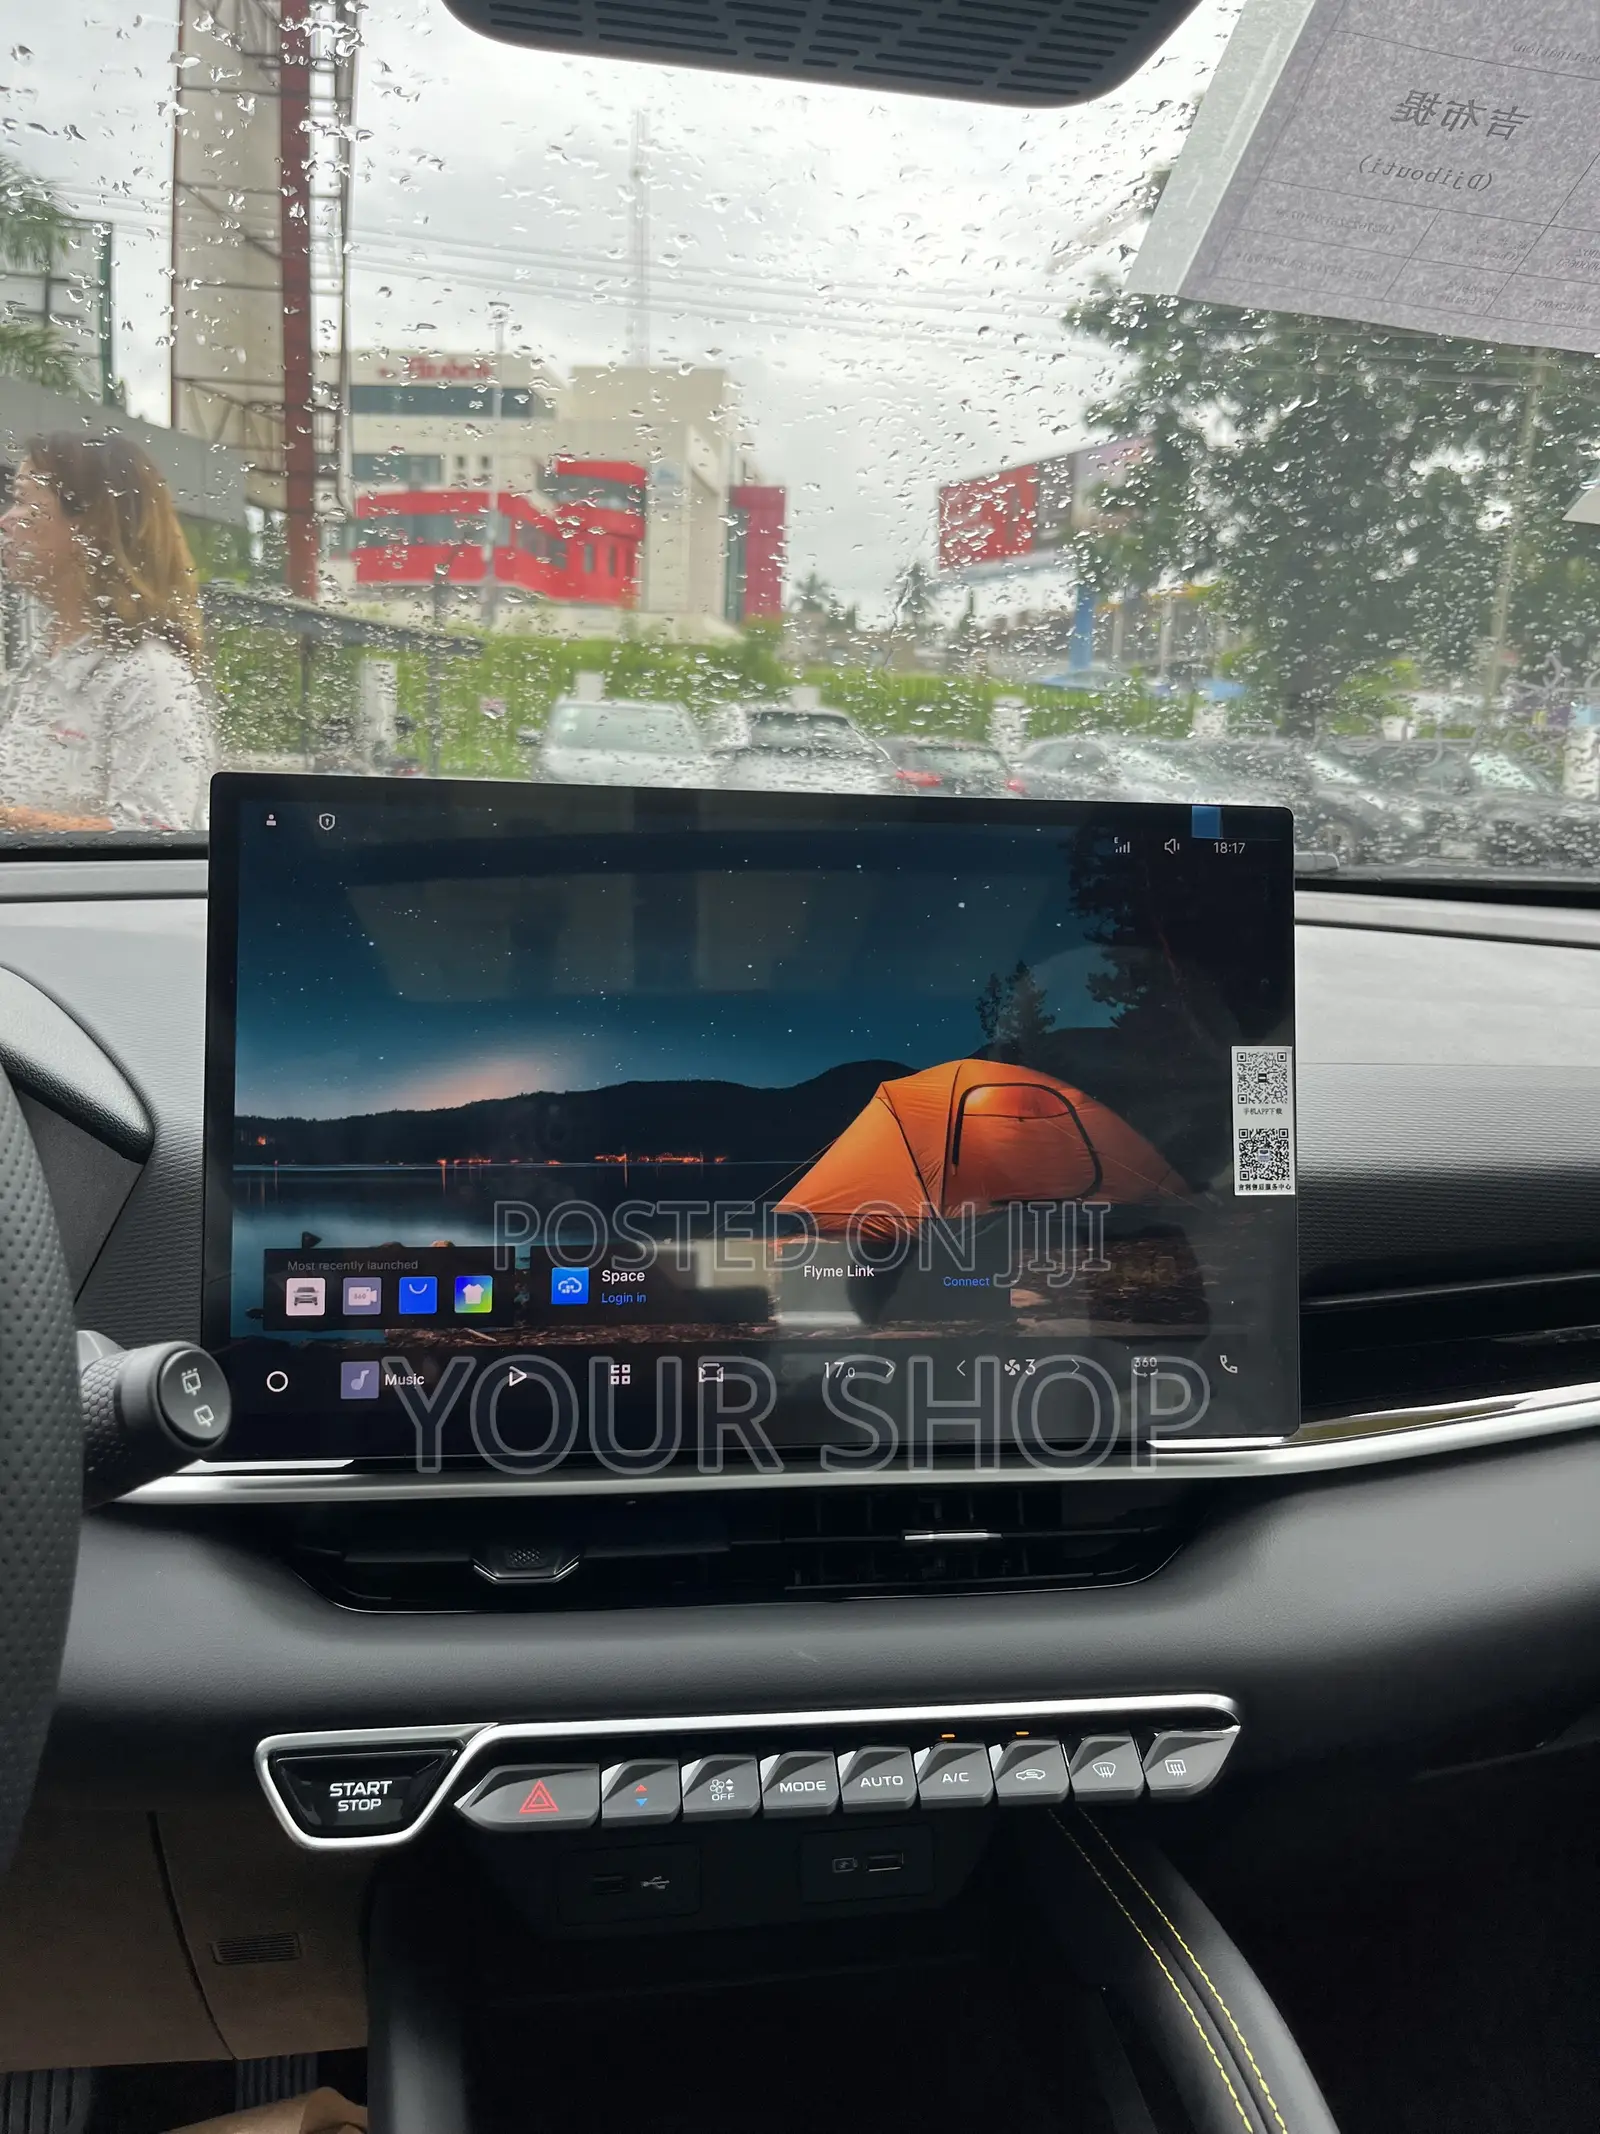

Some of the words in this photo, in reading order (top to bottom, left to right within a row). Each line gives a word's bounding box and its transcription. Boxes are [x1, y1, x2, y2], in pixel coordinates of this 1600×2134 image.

[1213, 841, 1246, 854] 18:17
[287, 1261, 316, 1271] Most
[318, 1260, 364, 1273] recently
[367, 1260, 419, 1271] launched
[803, 1264, 843, 1280] Flyme
[846, 1264, 875, 1278] Link
[601, 1269, 646, 1284] Space
[942, 1275, 991, 1288] Connect
[601, 1291, 633, 1304] Login
[636, 1291, 647, 1303] in
[1025, 1358, 1036, 1376] 3
[1133, 1356, 1158, 1368] 360
[384, 1372, 426, 1387] Music
[859, 1774, 904, 1788] AUTO
[941, 1770, 970, 1784] A/C
[328, 1779, 393, 1799] START
[779, 1779, 827, 1793] MODE
[710, 1791, 736, 1802] OFF
[336, 1796, 383, 1813] STOP
